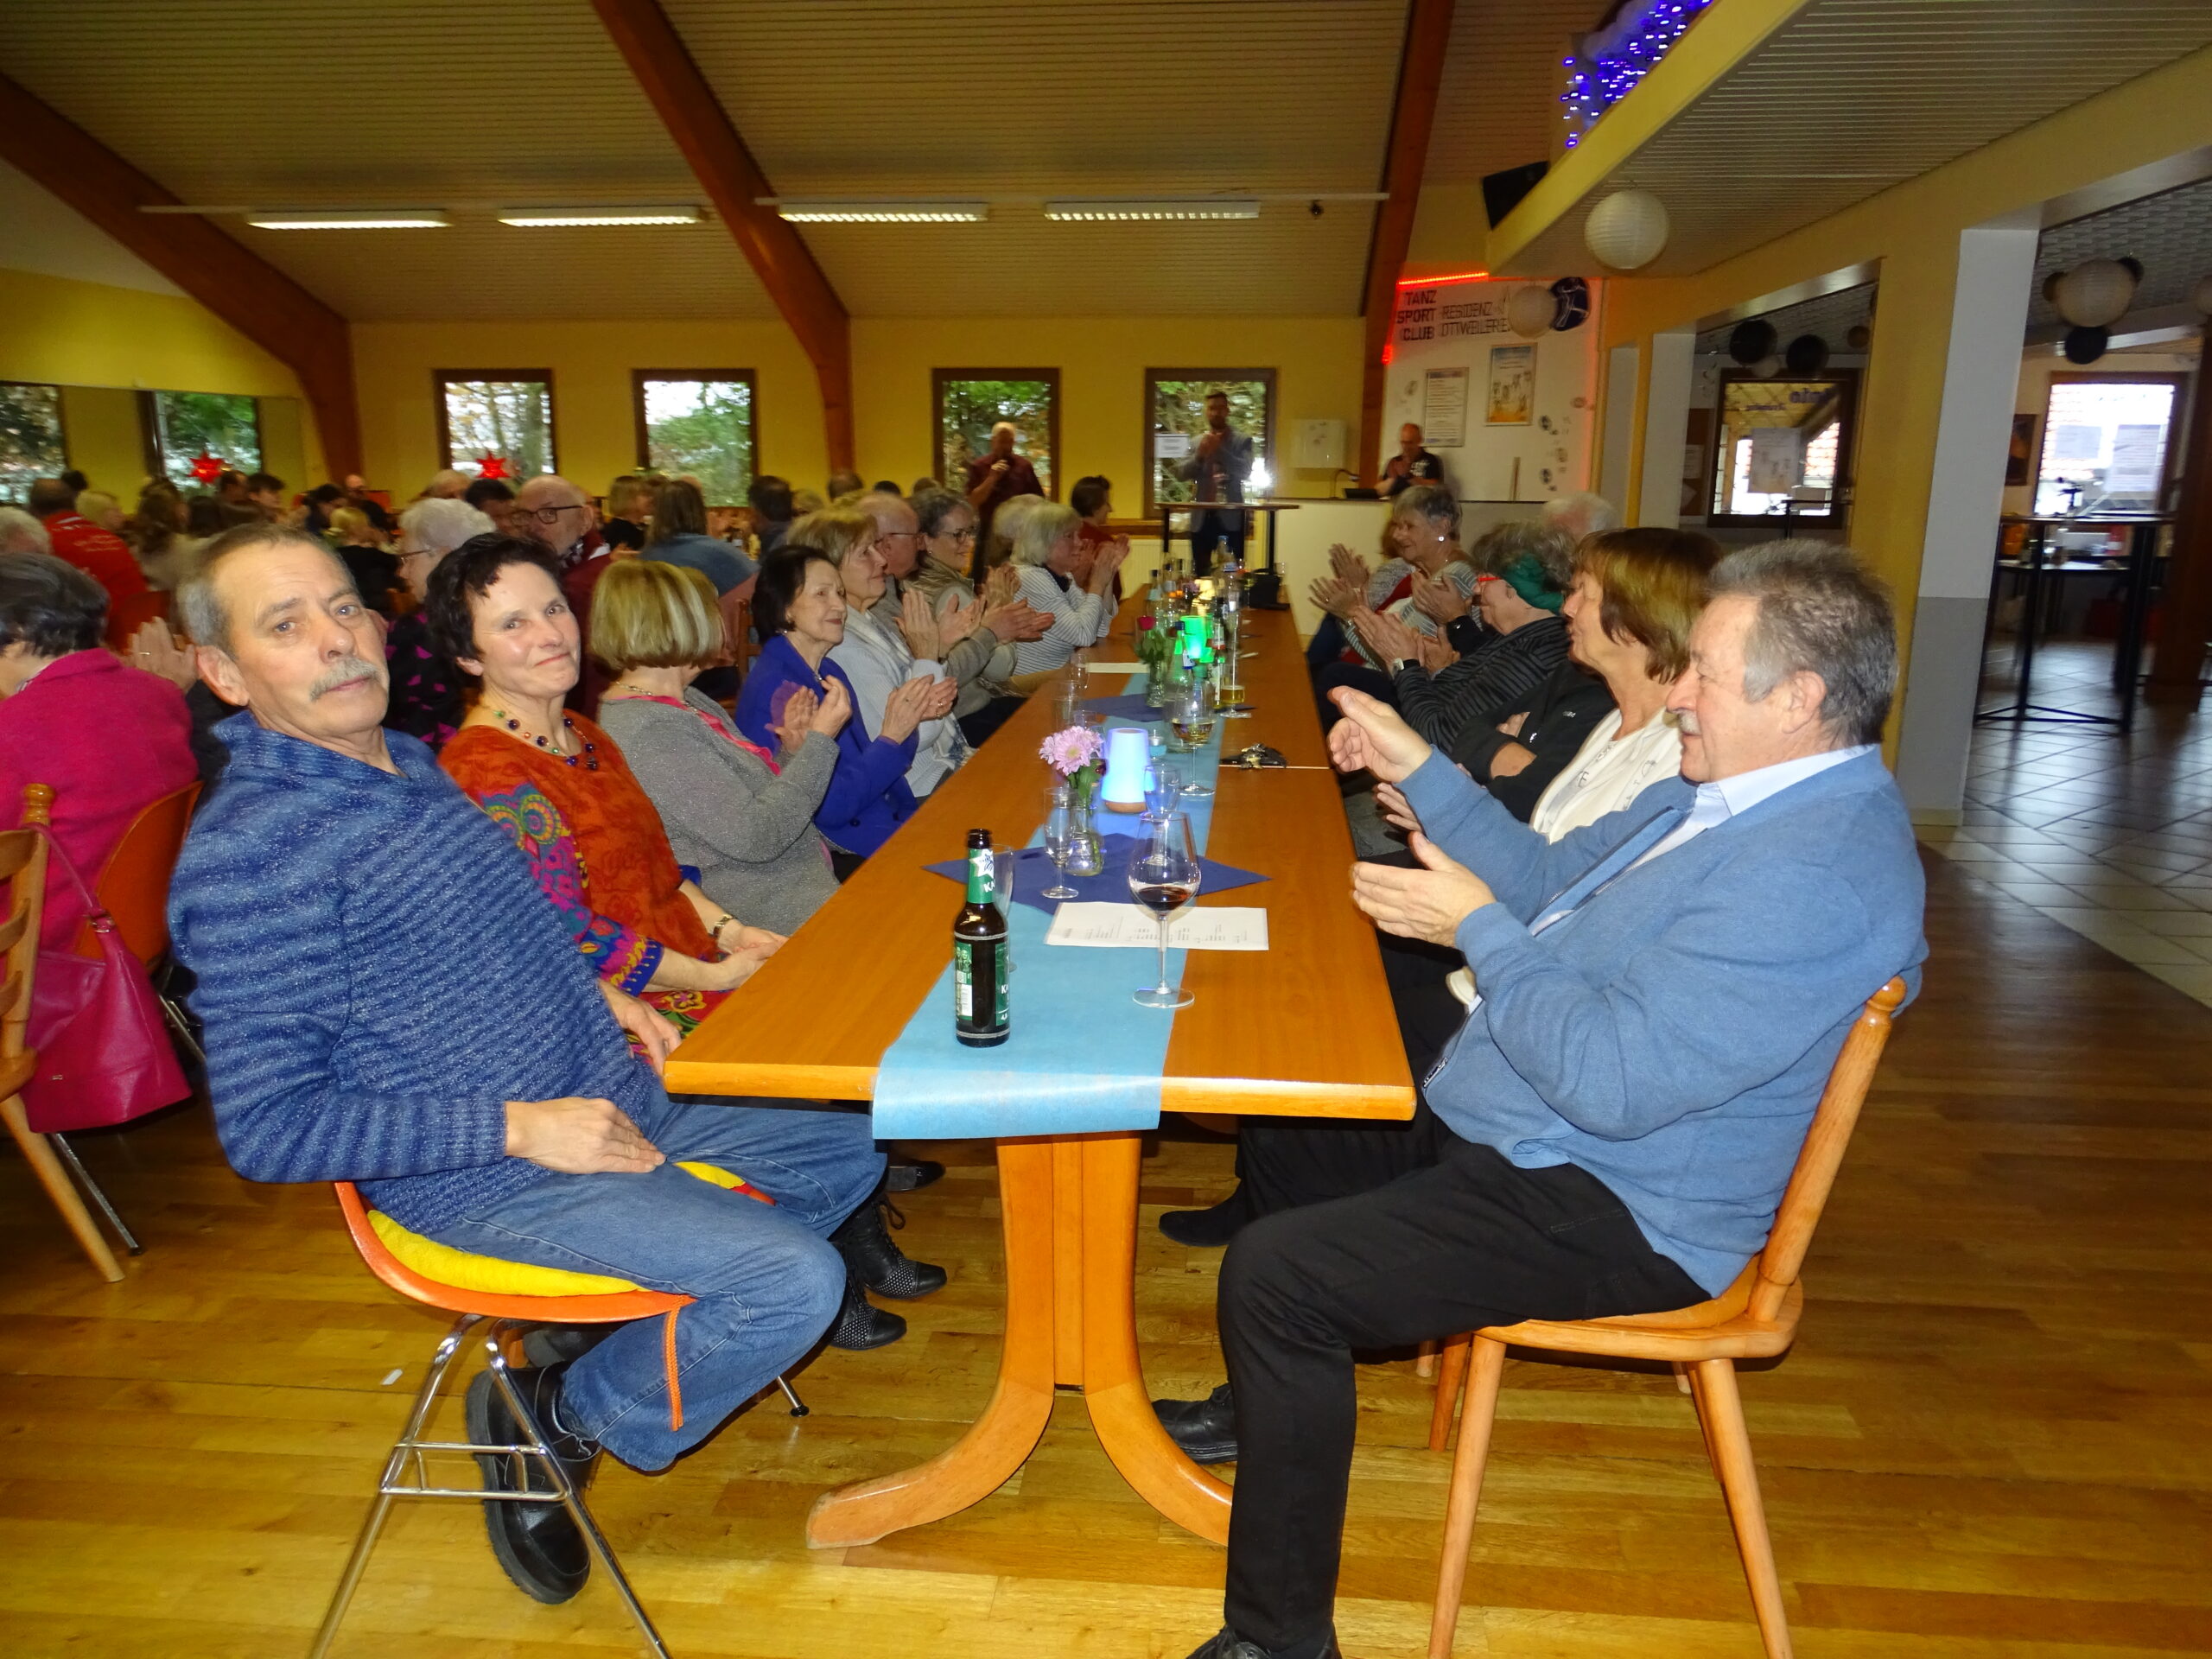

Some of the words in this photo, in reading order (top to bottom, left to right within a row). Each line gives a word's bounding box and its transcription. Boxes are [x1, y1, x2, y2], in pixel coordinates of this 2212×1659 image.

[1405, 290, 1437, 305] TANZ
[1397, 308, 1436, 324] SPORT
[1442, 302, 1493, 320] RESIDENZ
[1403, 327, 1434, 341] CLUB
